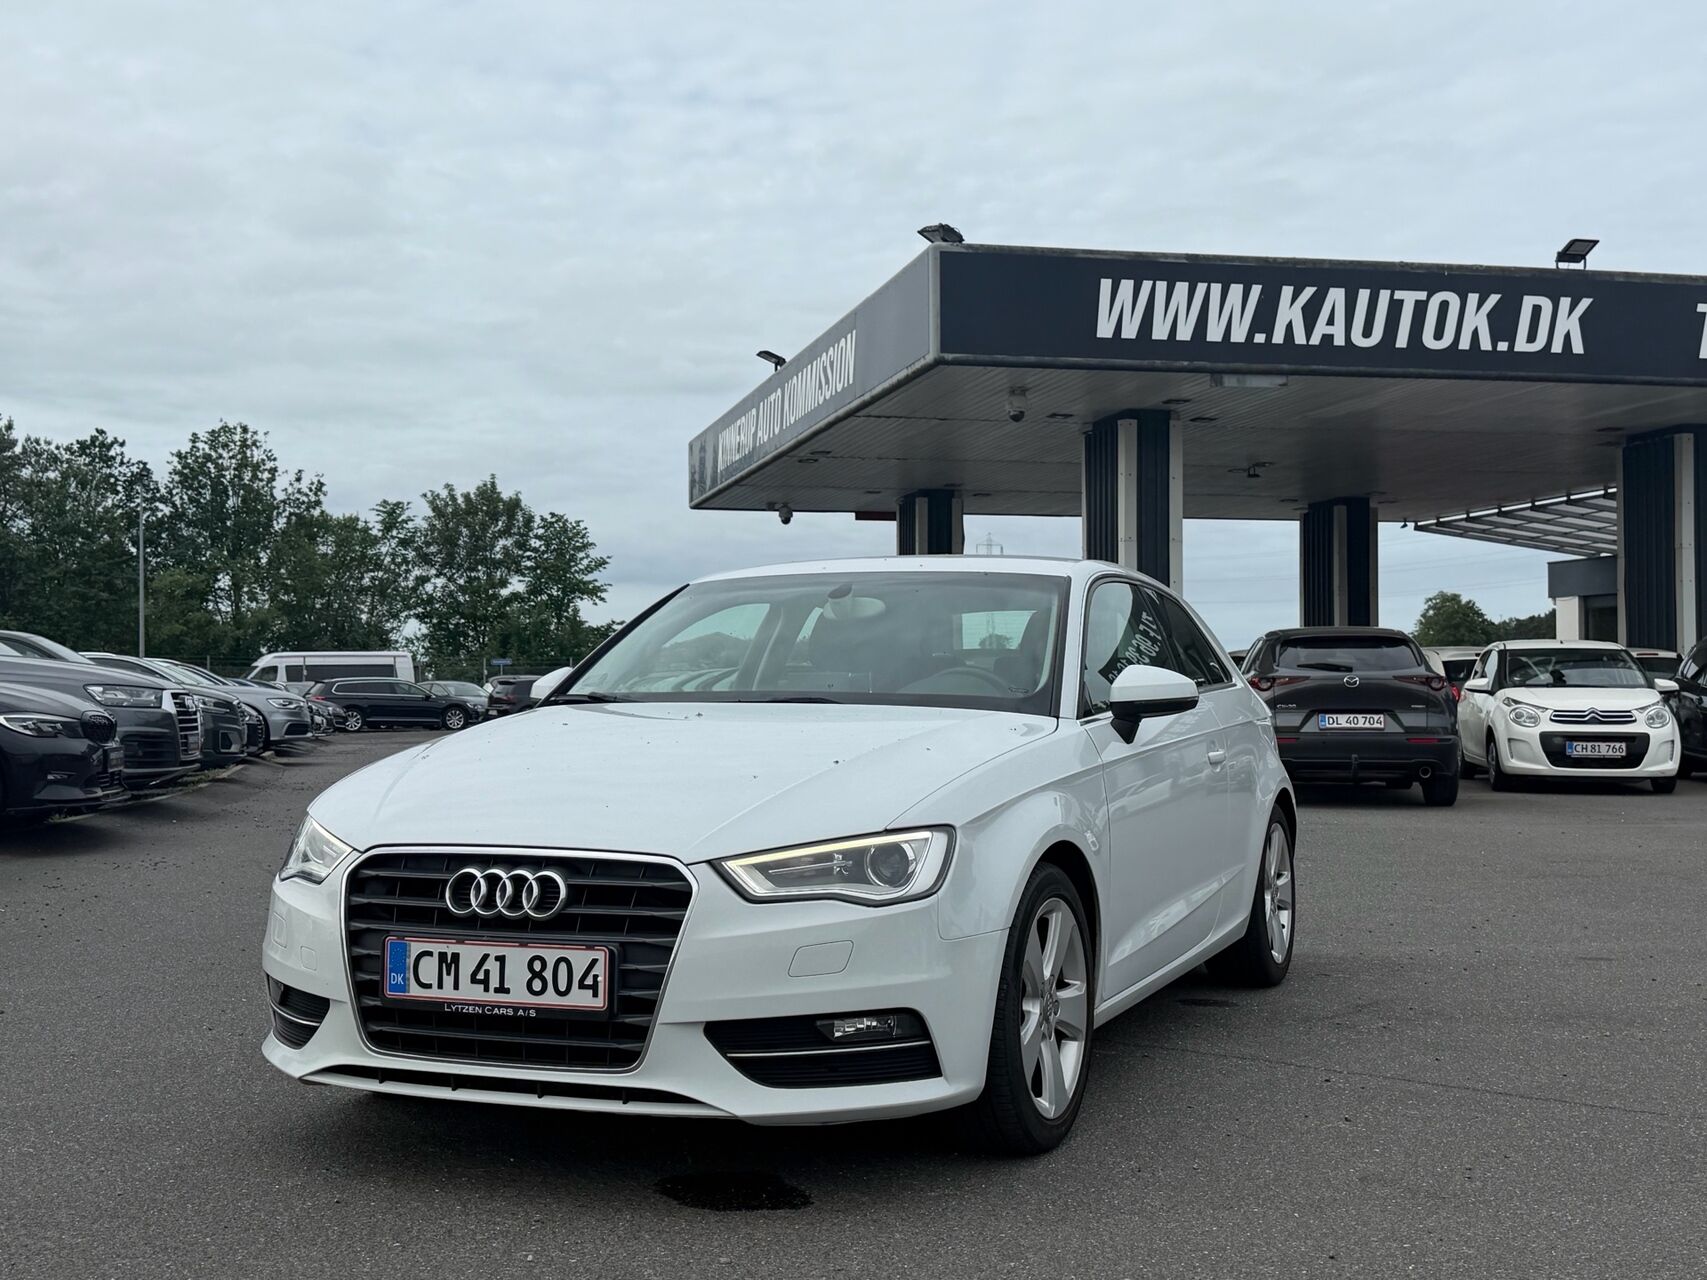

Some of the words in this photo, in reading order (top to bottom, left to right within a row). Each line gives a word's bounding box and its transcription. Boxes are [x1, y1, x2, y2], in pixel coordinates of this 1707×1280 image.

[1096, 278, 1594, 355] WWW.KAUTOK.DK
[757, 388, 782, 447] AUTO
[783, 329, 856, 430] KOMMISSION
[1327, 716, 1342, 726] DL
[1345, 716, 1359, 726] 40
[1361, 716, 1382, 726] 704
[1574, 744, 1588, 753] CH
[1590, 744, 1602, 754] 81
[1605, 744, 1624, 754] 766
[390, 973, 404, 985] DK
[412, 949, 460, 991] CM
[470, 952, 511, 995] 41
[525, 954, 600, 998] 804
[444, 1003, 482, 1014] LYTZEN
[485, 1006, 514, 1016] CARS
[517, 1009, 537, 1017] A/S
